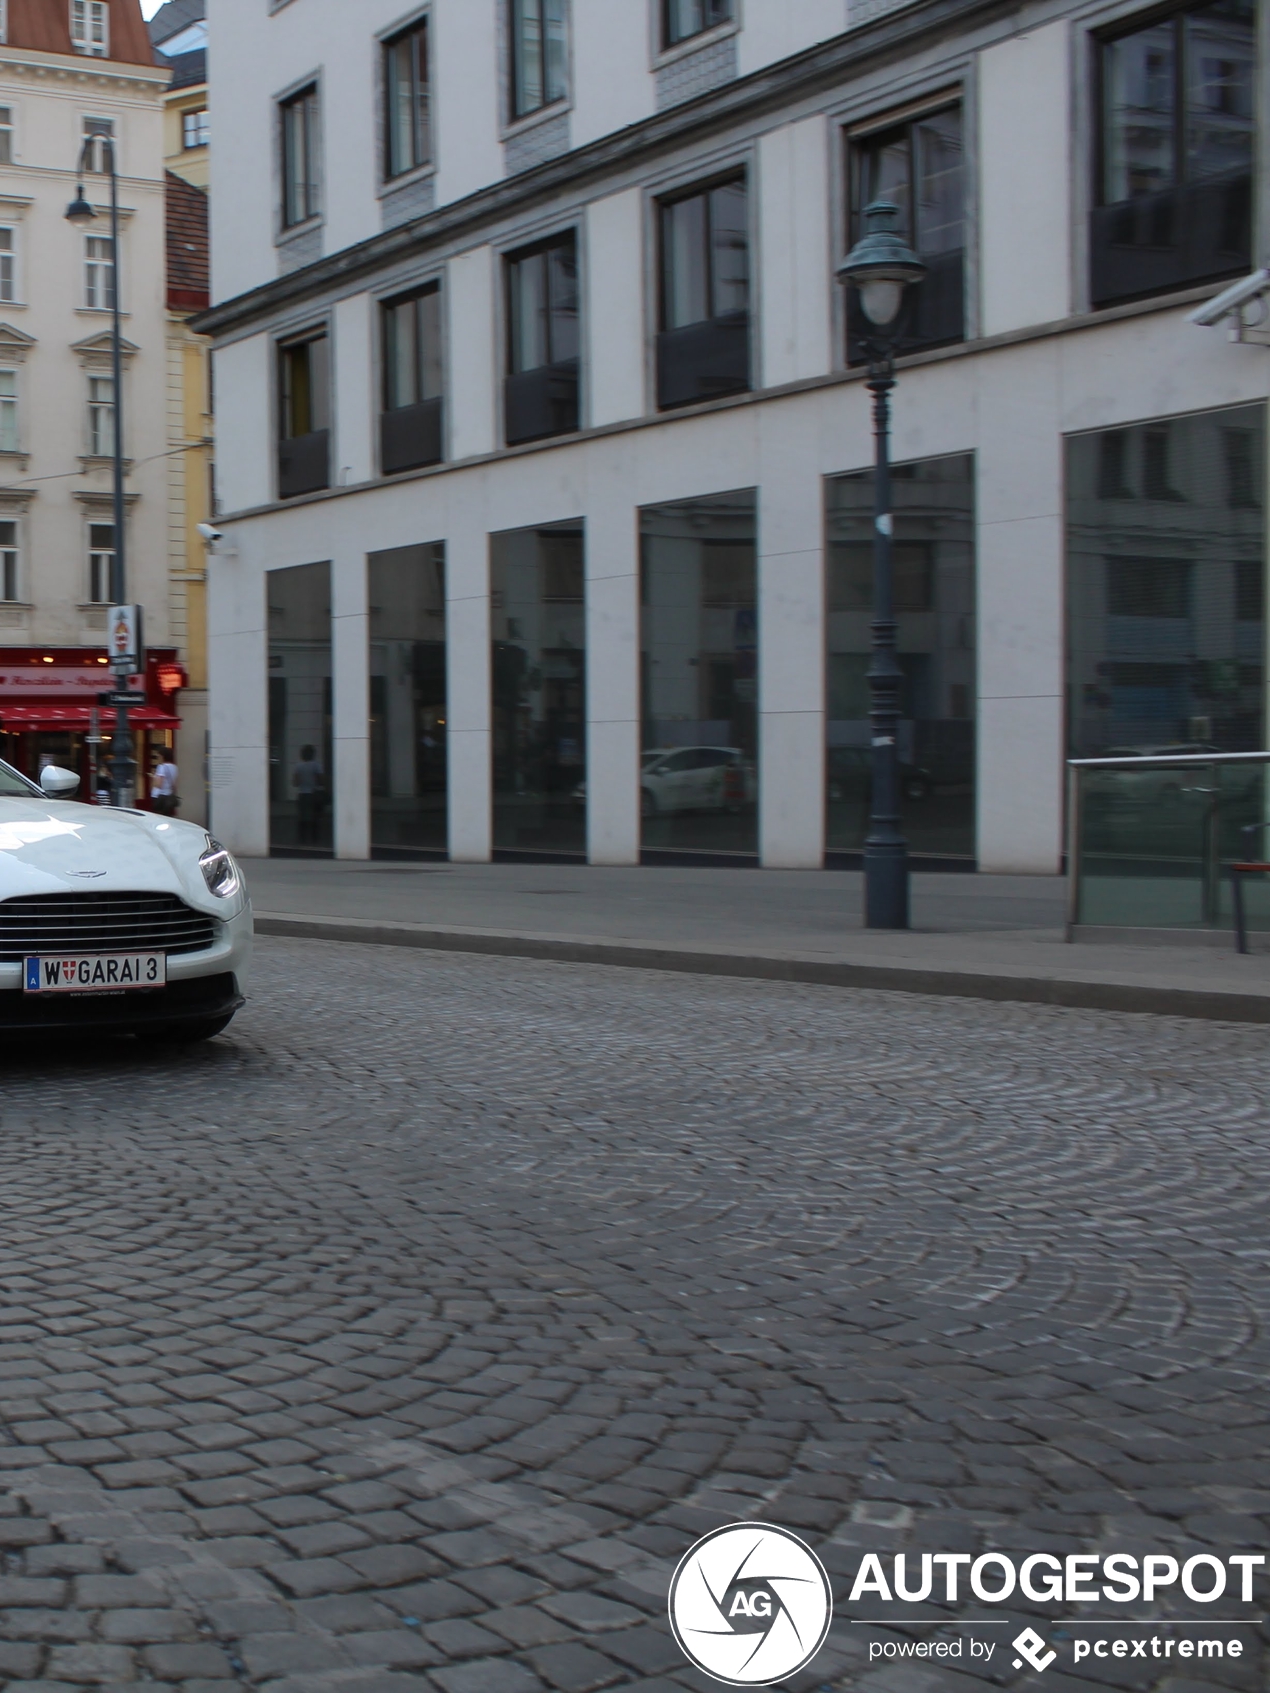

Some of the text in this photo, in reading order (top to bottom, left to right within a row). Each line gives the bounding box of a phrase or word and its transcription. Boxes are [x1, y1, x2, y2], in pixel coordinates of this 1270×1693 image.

[44, 957, 158, 985] W GARAI 3
